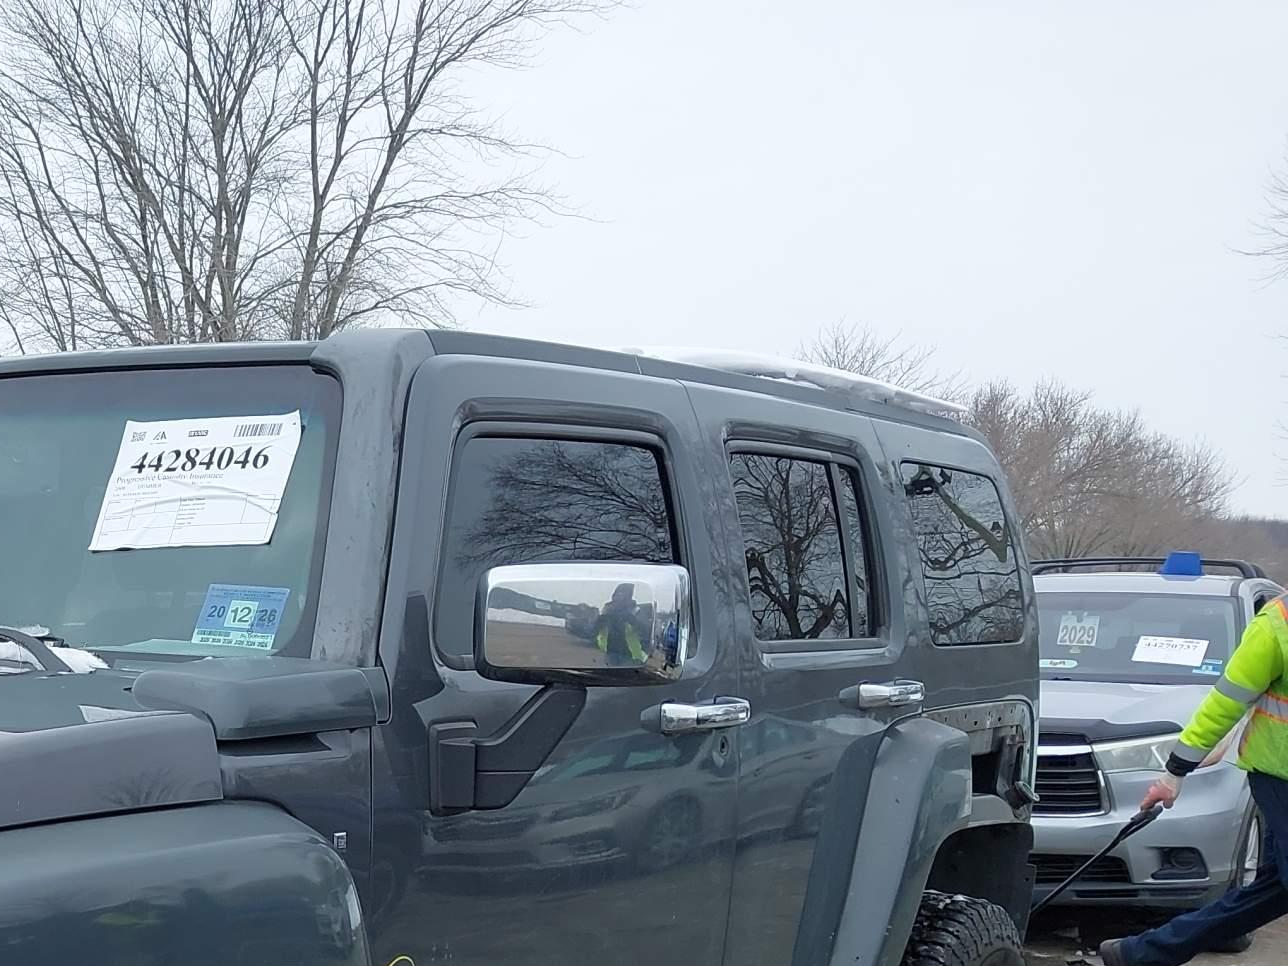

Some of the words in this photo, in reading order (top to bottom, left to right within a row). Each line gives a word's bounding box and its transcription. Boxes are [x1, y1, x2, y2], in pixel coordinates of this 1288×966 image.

[130, 446, 271, 474] 44284046
[207, 605, 226, 618] 20
[230, 606, 252, 623] 12
[258, 609, 277, 624] 26
[1059, 625, 1096, 645] 2029
